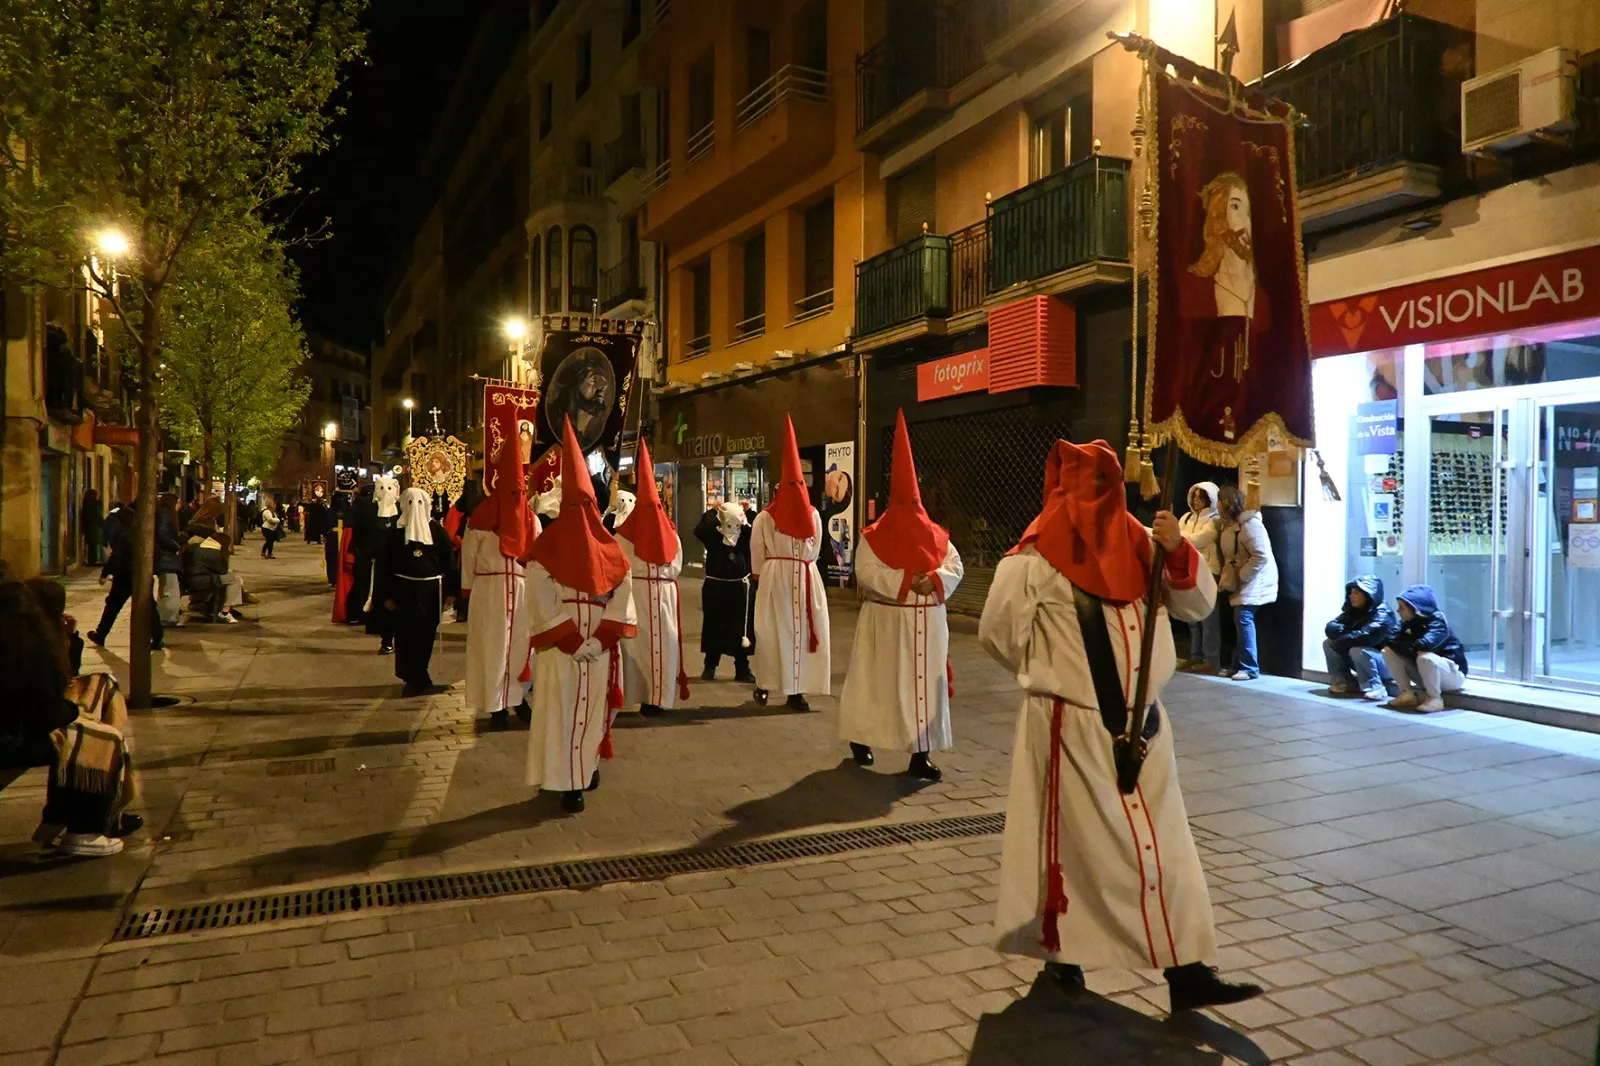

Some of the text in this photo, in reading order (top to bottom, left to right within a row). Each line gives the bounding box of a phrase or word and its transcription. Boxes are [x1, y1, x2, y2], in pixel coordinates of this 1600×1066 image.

[1379, 268, 1585, 333] VISIONLAB
[934, 355, 984, 384] fotoprix
[1369, 424, 1396, 437] Vista
[727, 434, 765, 453] farmacia
[828, 446, 852, 458] PHYTO
